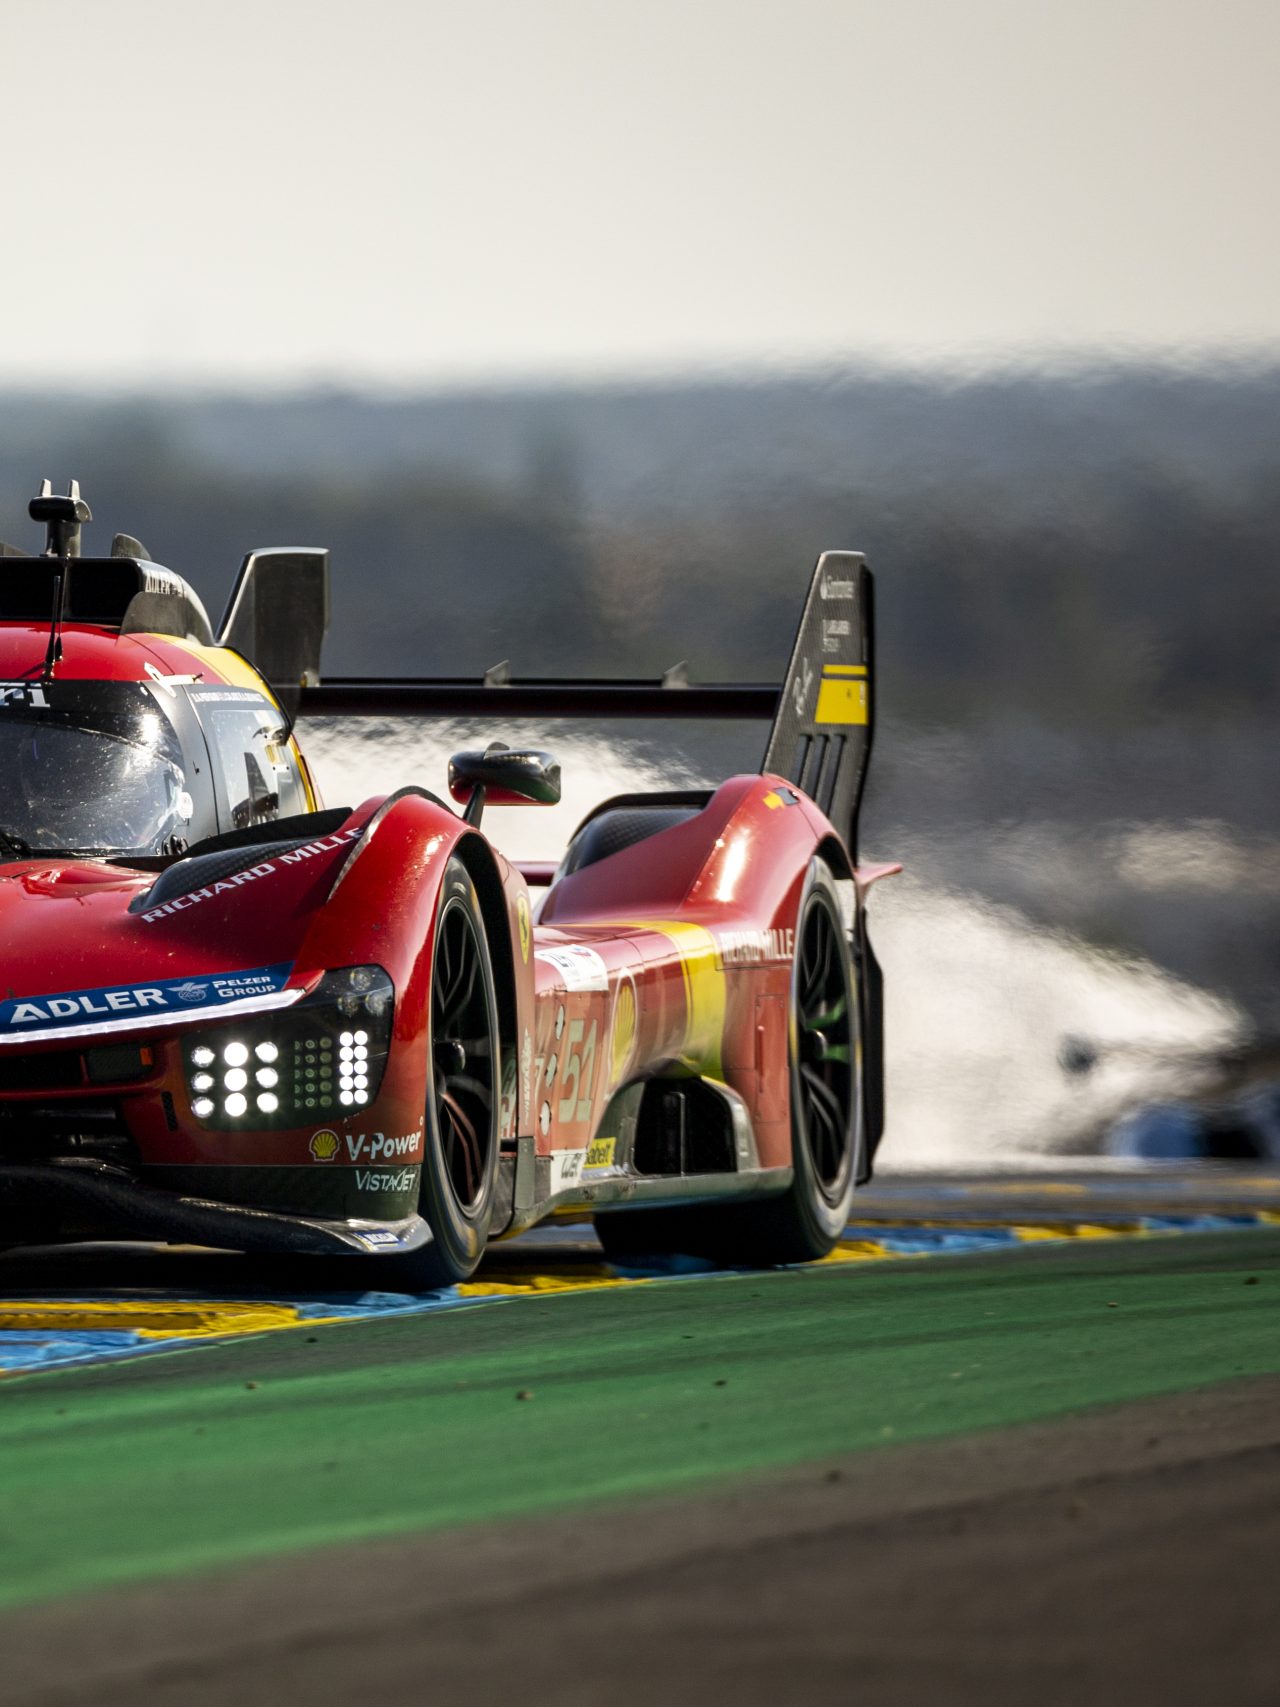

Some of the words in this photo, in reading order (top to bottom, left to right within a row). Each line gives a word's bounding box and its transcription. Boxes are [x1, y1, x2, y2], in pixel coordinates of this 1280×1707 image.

[141, 863, 276, 923] RICHARD
[280, 827, 364, 865] MILLE
[10, 987, 168, 1024] ADLER
[217, 985, 276, 998] GROUP
[558, 1018, 597, 1123] 51
[346, 1131, 421, 1161] V-Power
